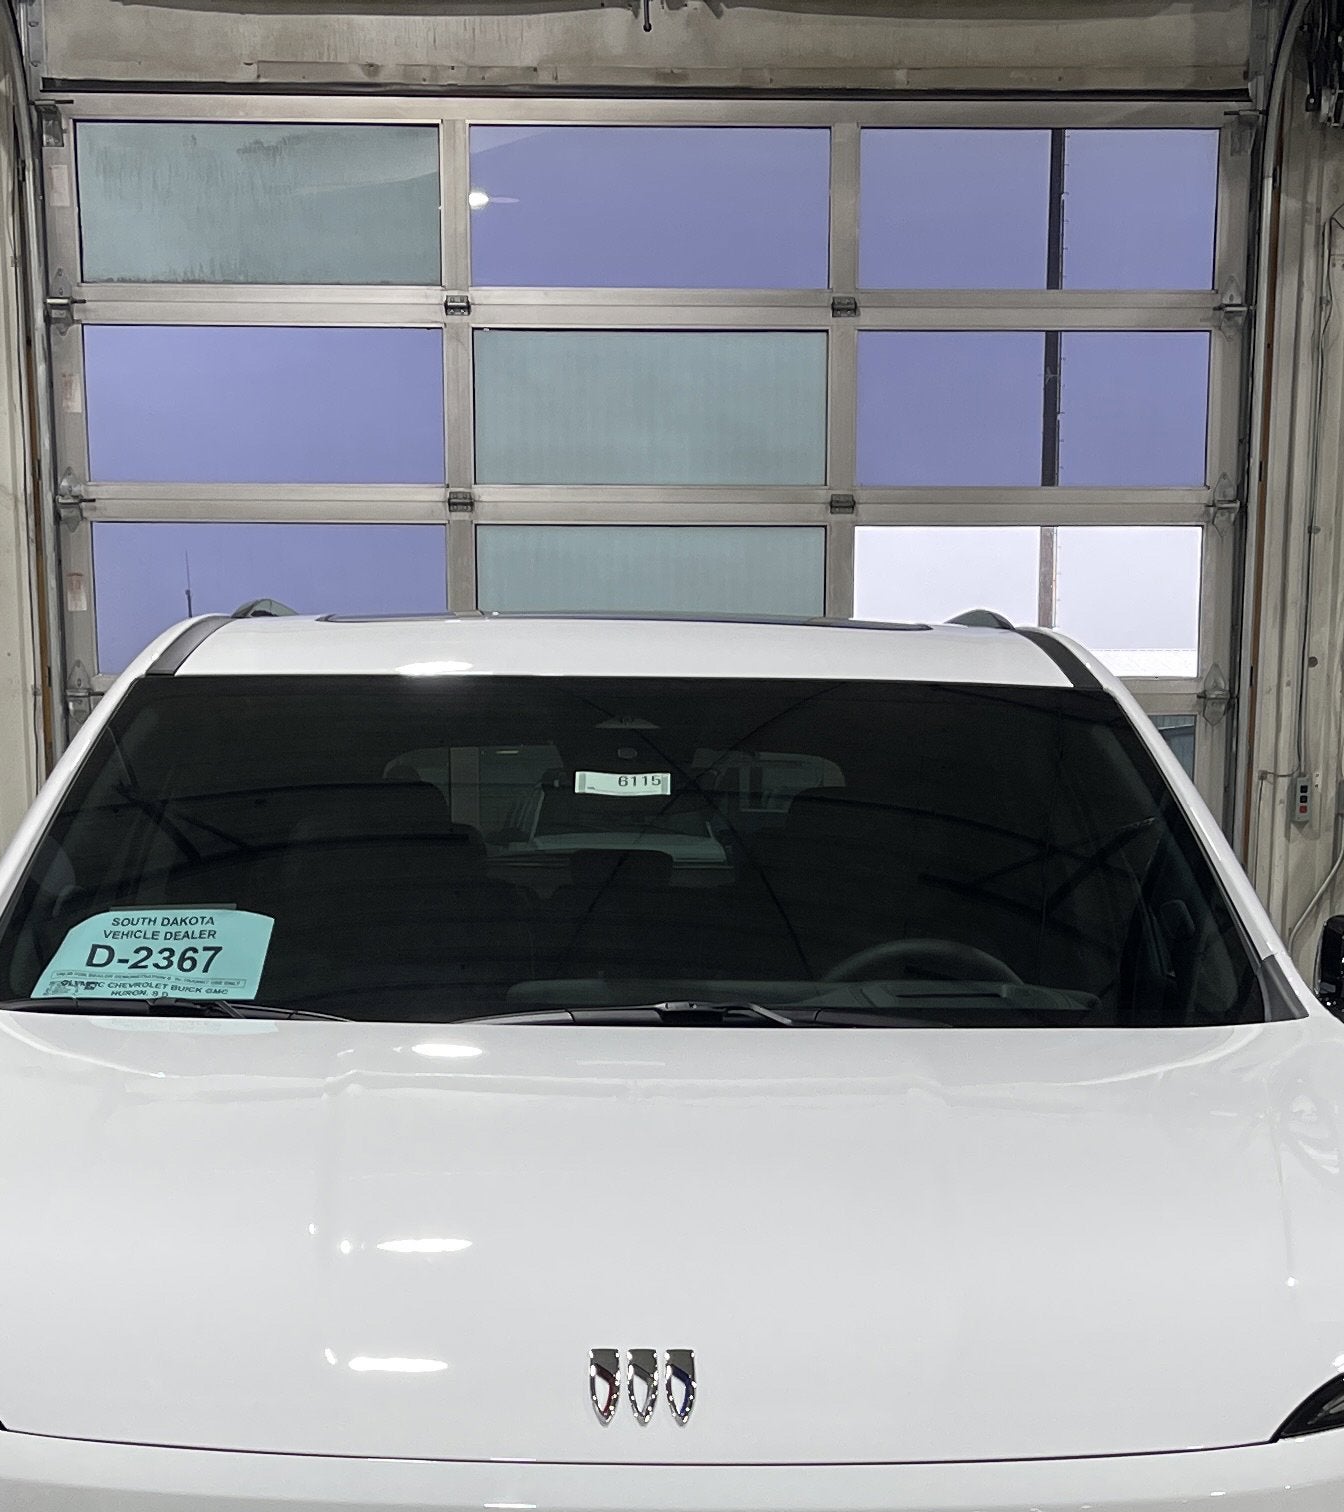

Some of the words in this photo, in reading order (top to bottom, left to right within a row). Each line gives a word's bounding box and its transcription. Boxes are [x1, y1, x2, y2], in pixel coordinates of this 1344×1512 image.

[618, 775, 662, 787] 6115
[111, 917, 157, 926] SOUTH
[160, 916, 215, 926] DAKOTA
[103, 930, 160, 940] VEHICLE
[164, 930, 217, 941] DEALER
[85, 943, 223, 973] D-2367
[108, 981, 168, 990] CHEVROLET
[170, 984, 202, 993] BUICK
[205, 987, 228, 995] GMC
